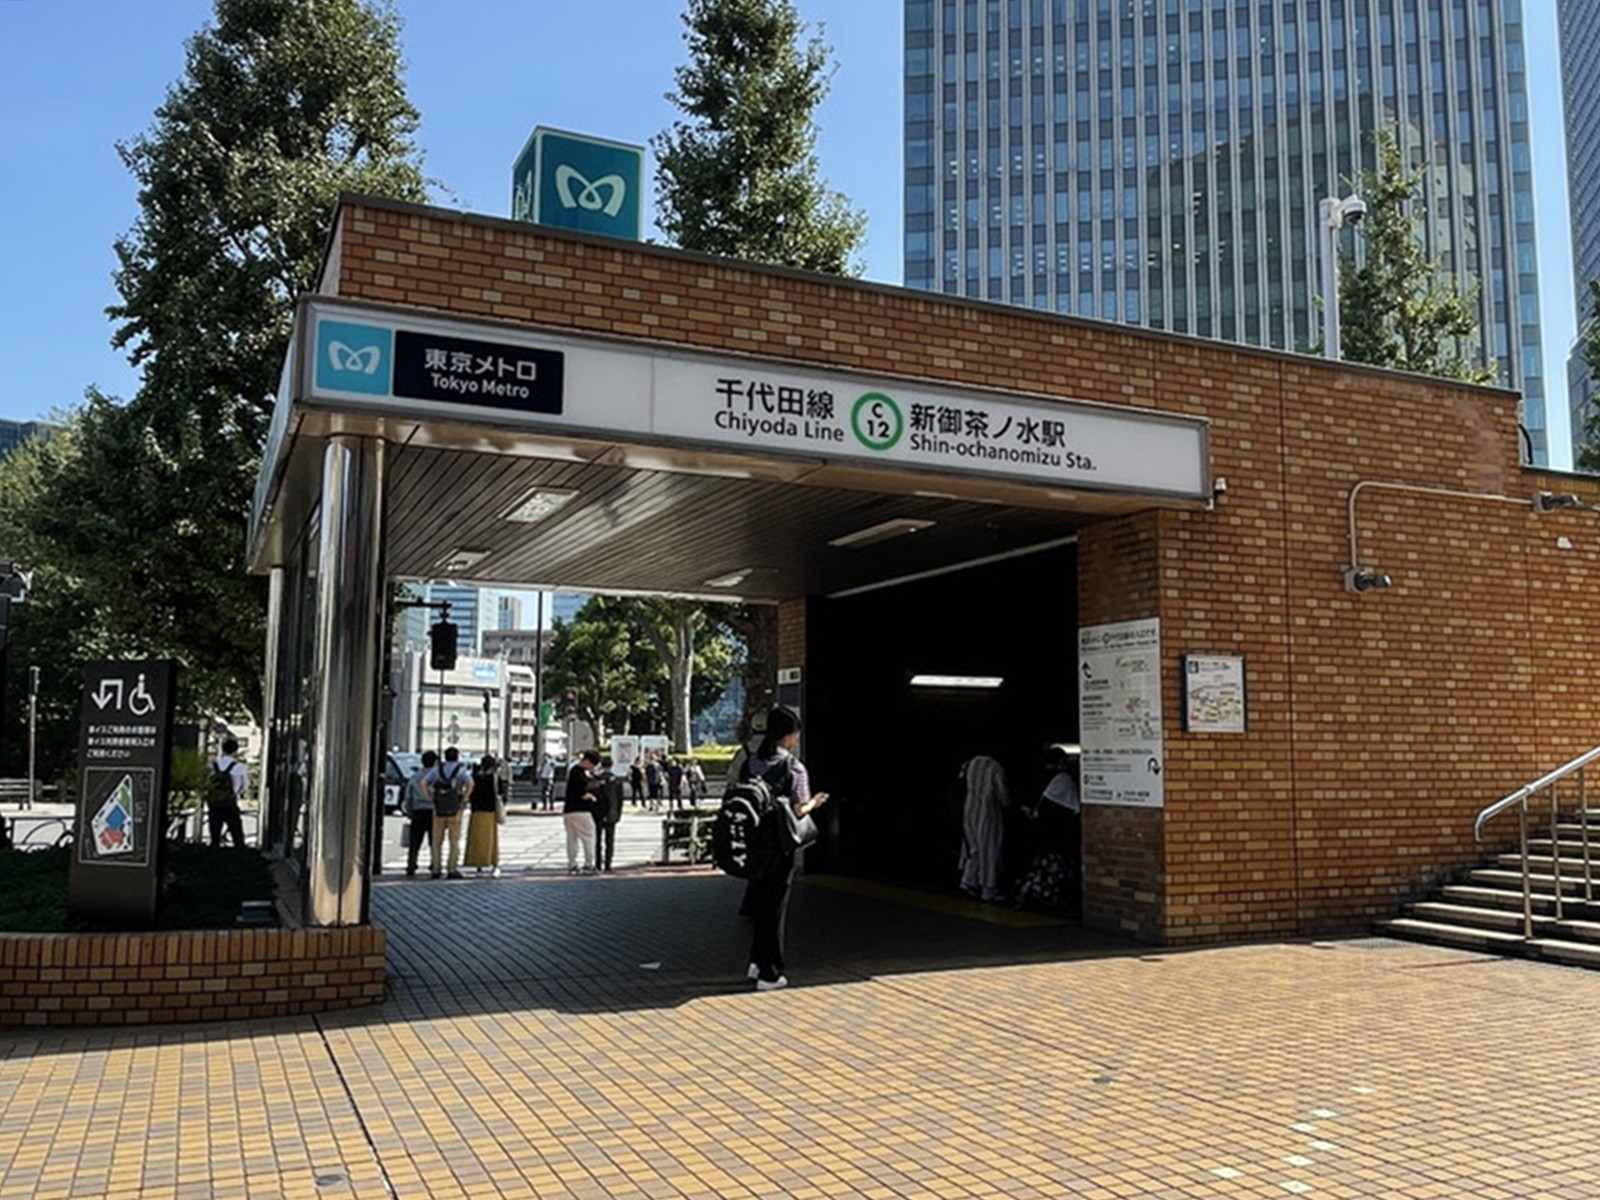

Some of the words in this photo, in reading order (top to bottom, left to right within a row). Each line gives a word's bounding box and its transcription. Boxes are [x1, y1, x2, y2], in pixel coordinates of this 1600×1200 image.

[424, 348, 536, 380] 東京メトロ
[431, 373, 478, 394] Tokyo
[482, 379, 529, 398] Metro
[715, 378, 835, 421] 千代田線
[714, 410, 798, 437] Chiyoda
[804, 420, 845, 442] Line
[871, 402, 883, 419] C
[909, 402, 1066, 448] 新御茶ノ水駅
[867, 419, 890, 439] 12
[909, 433, 1061, 467] Shin-ochanomizu
[1065, 451, 1097, 471] Sta.
